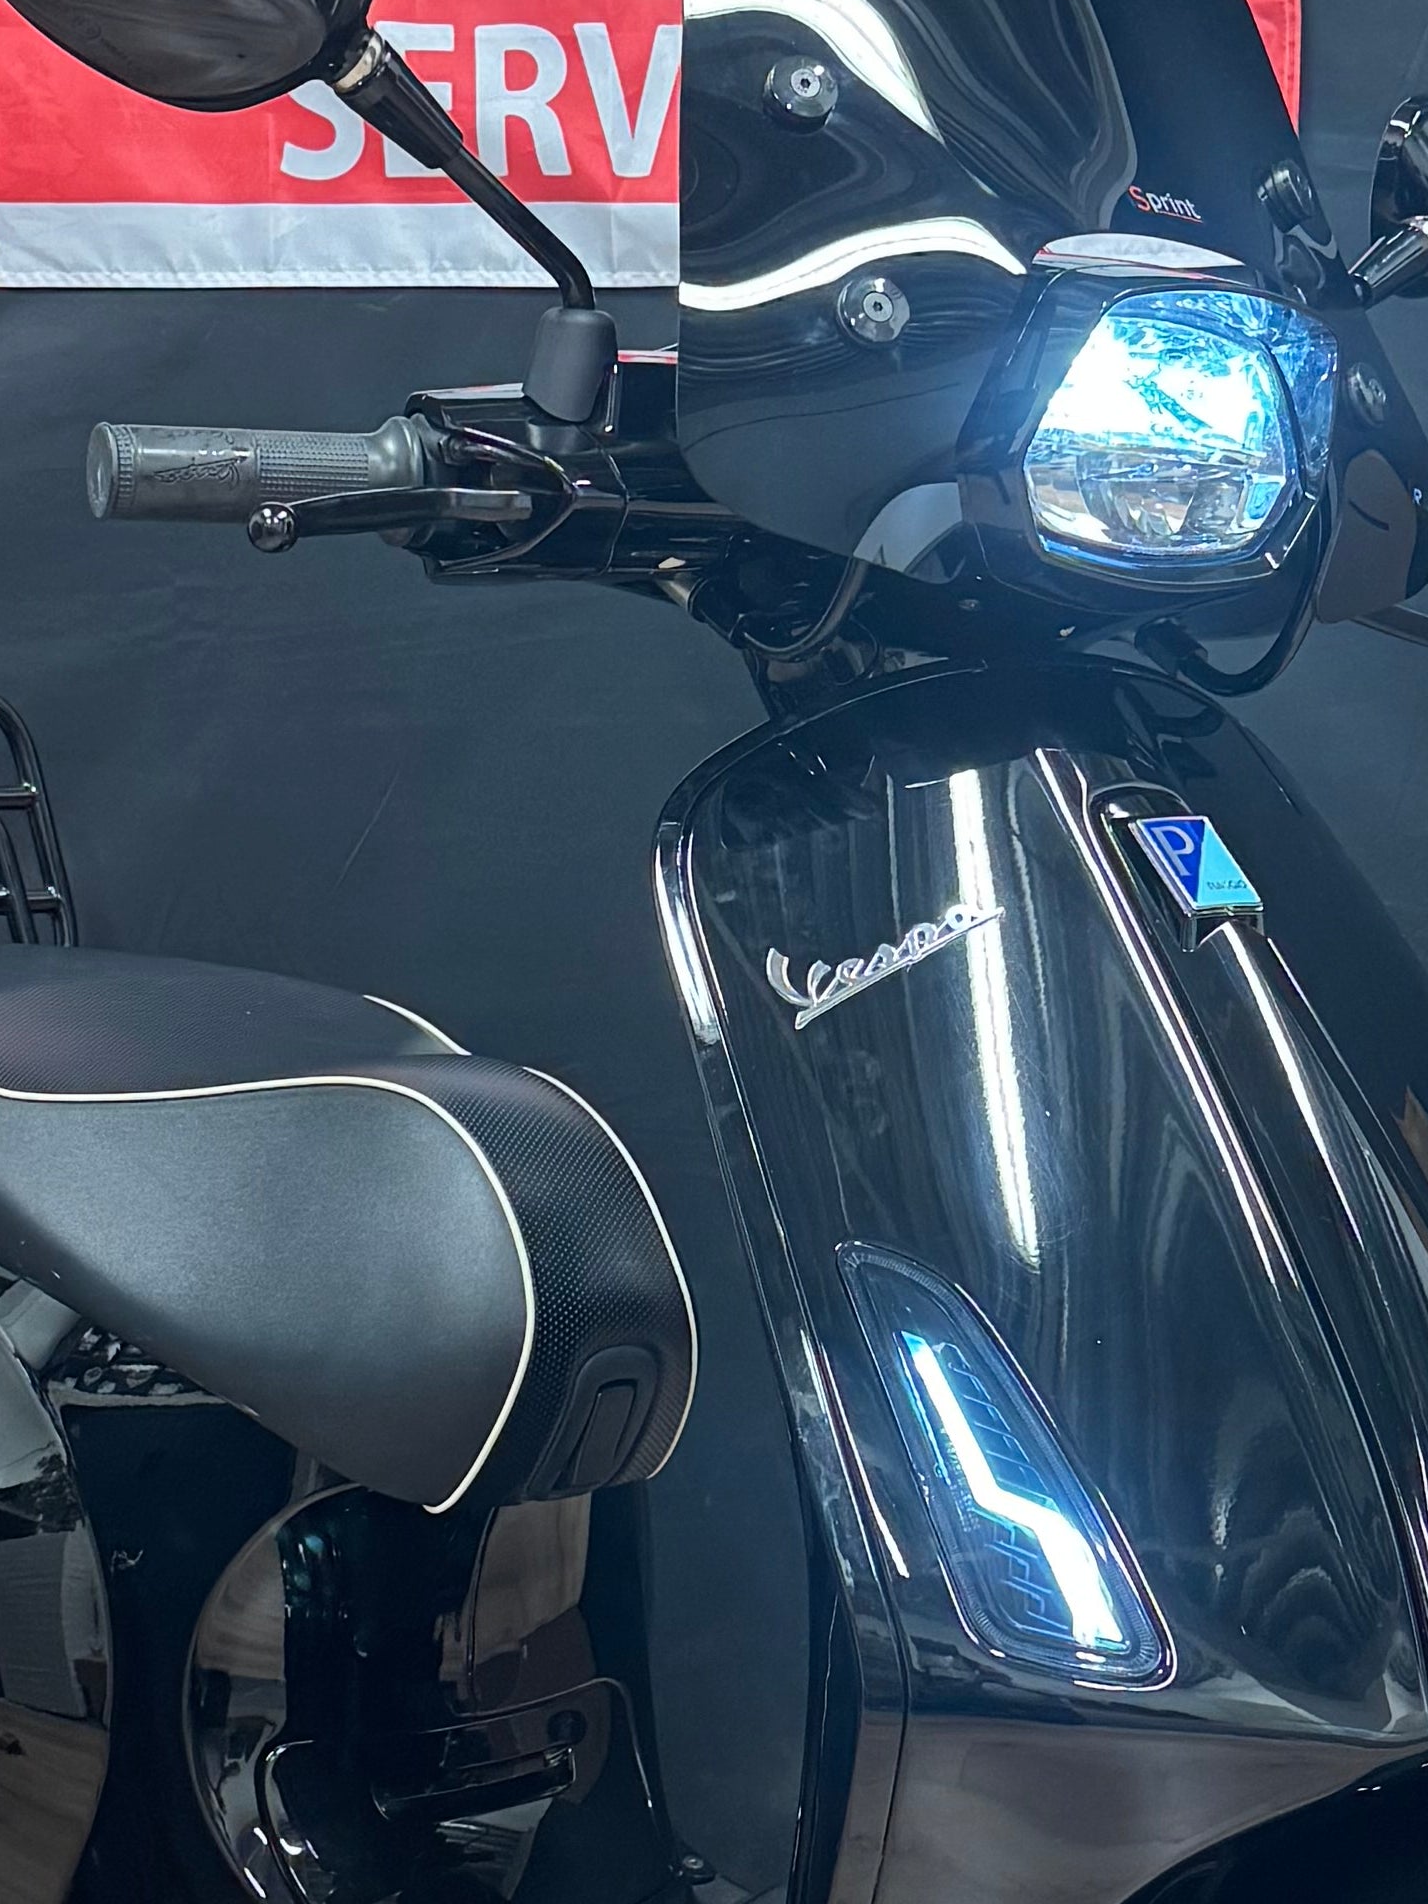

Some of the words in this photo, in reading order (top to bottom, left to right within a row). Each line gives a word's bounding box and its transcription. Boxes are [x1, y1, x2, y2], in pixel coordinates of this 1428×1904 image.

[1128, 185, 1201, 220] Sprint
[1150, 825, 1195, 877] P
[766, 907, 1006, 1030] Vespa
